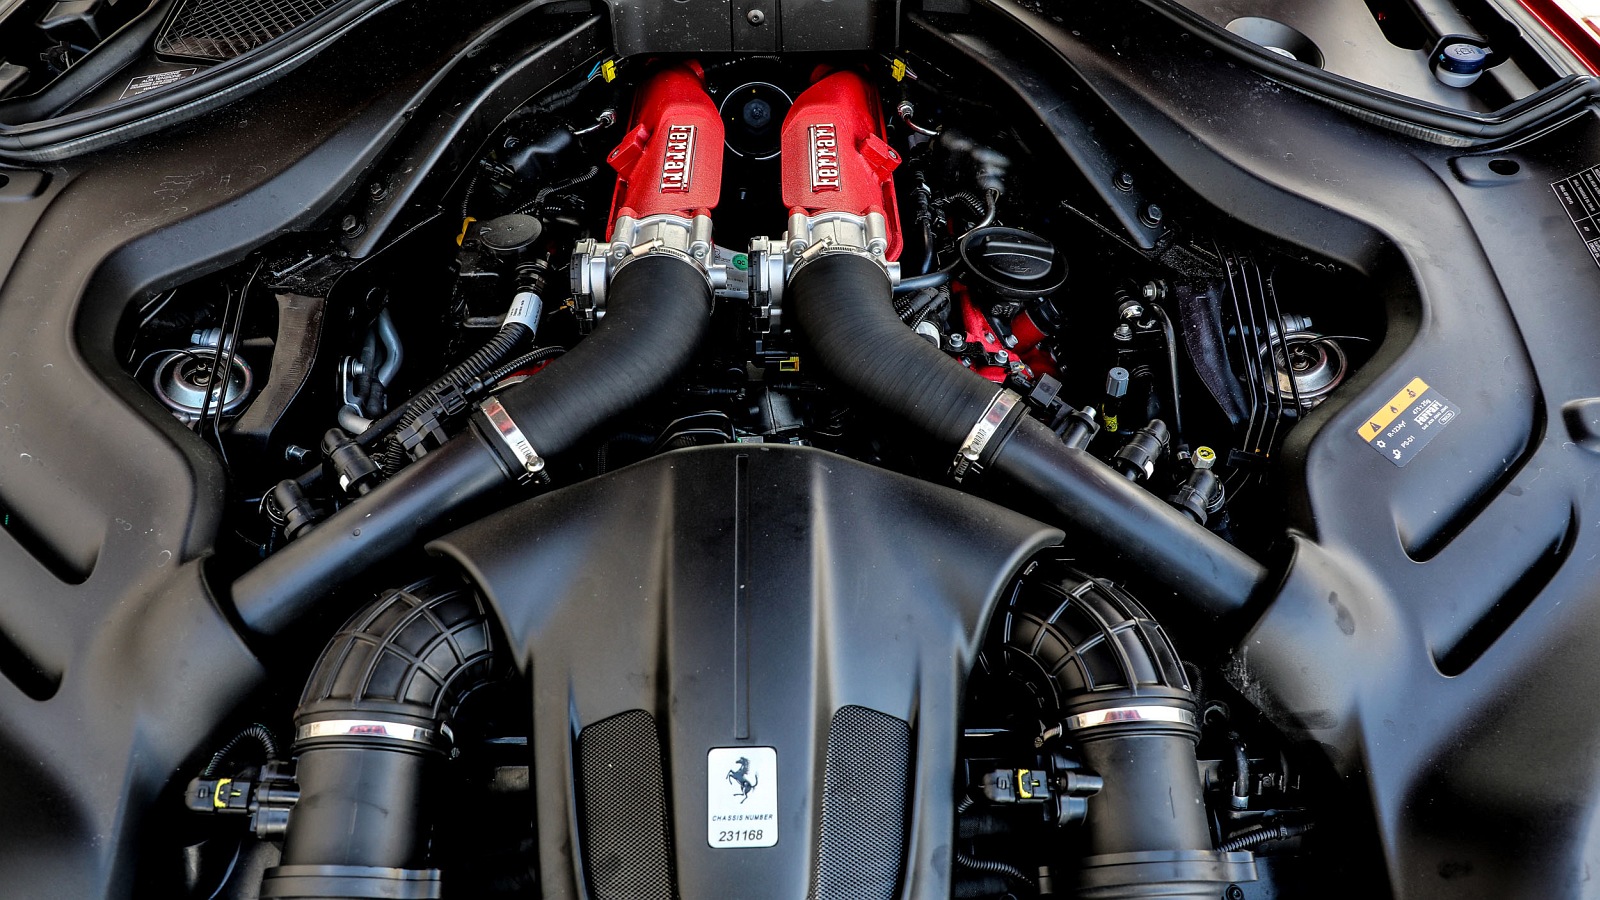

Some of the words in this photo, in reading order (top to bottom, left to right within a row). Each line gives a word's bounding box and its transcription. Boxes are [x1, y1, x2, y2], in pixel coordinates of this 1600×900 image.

[661, 124, 695, 190] Ferrari
[809, 123, 839, 187] Ferrari
[1413, 399, 1443, 426] Ferrari
[712, 814, 743, 822] CHASSIS
[745, 813, 773, 821] NUMBER
[718, 829, 763, 842] 231168
